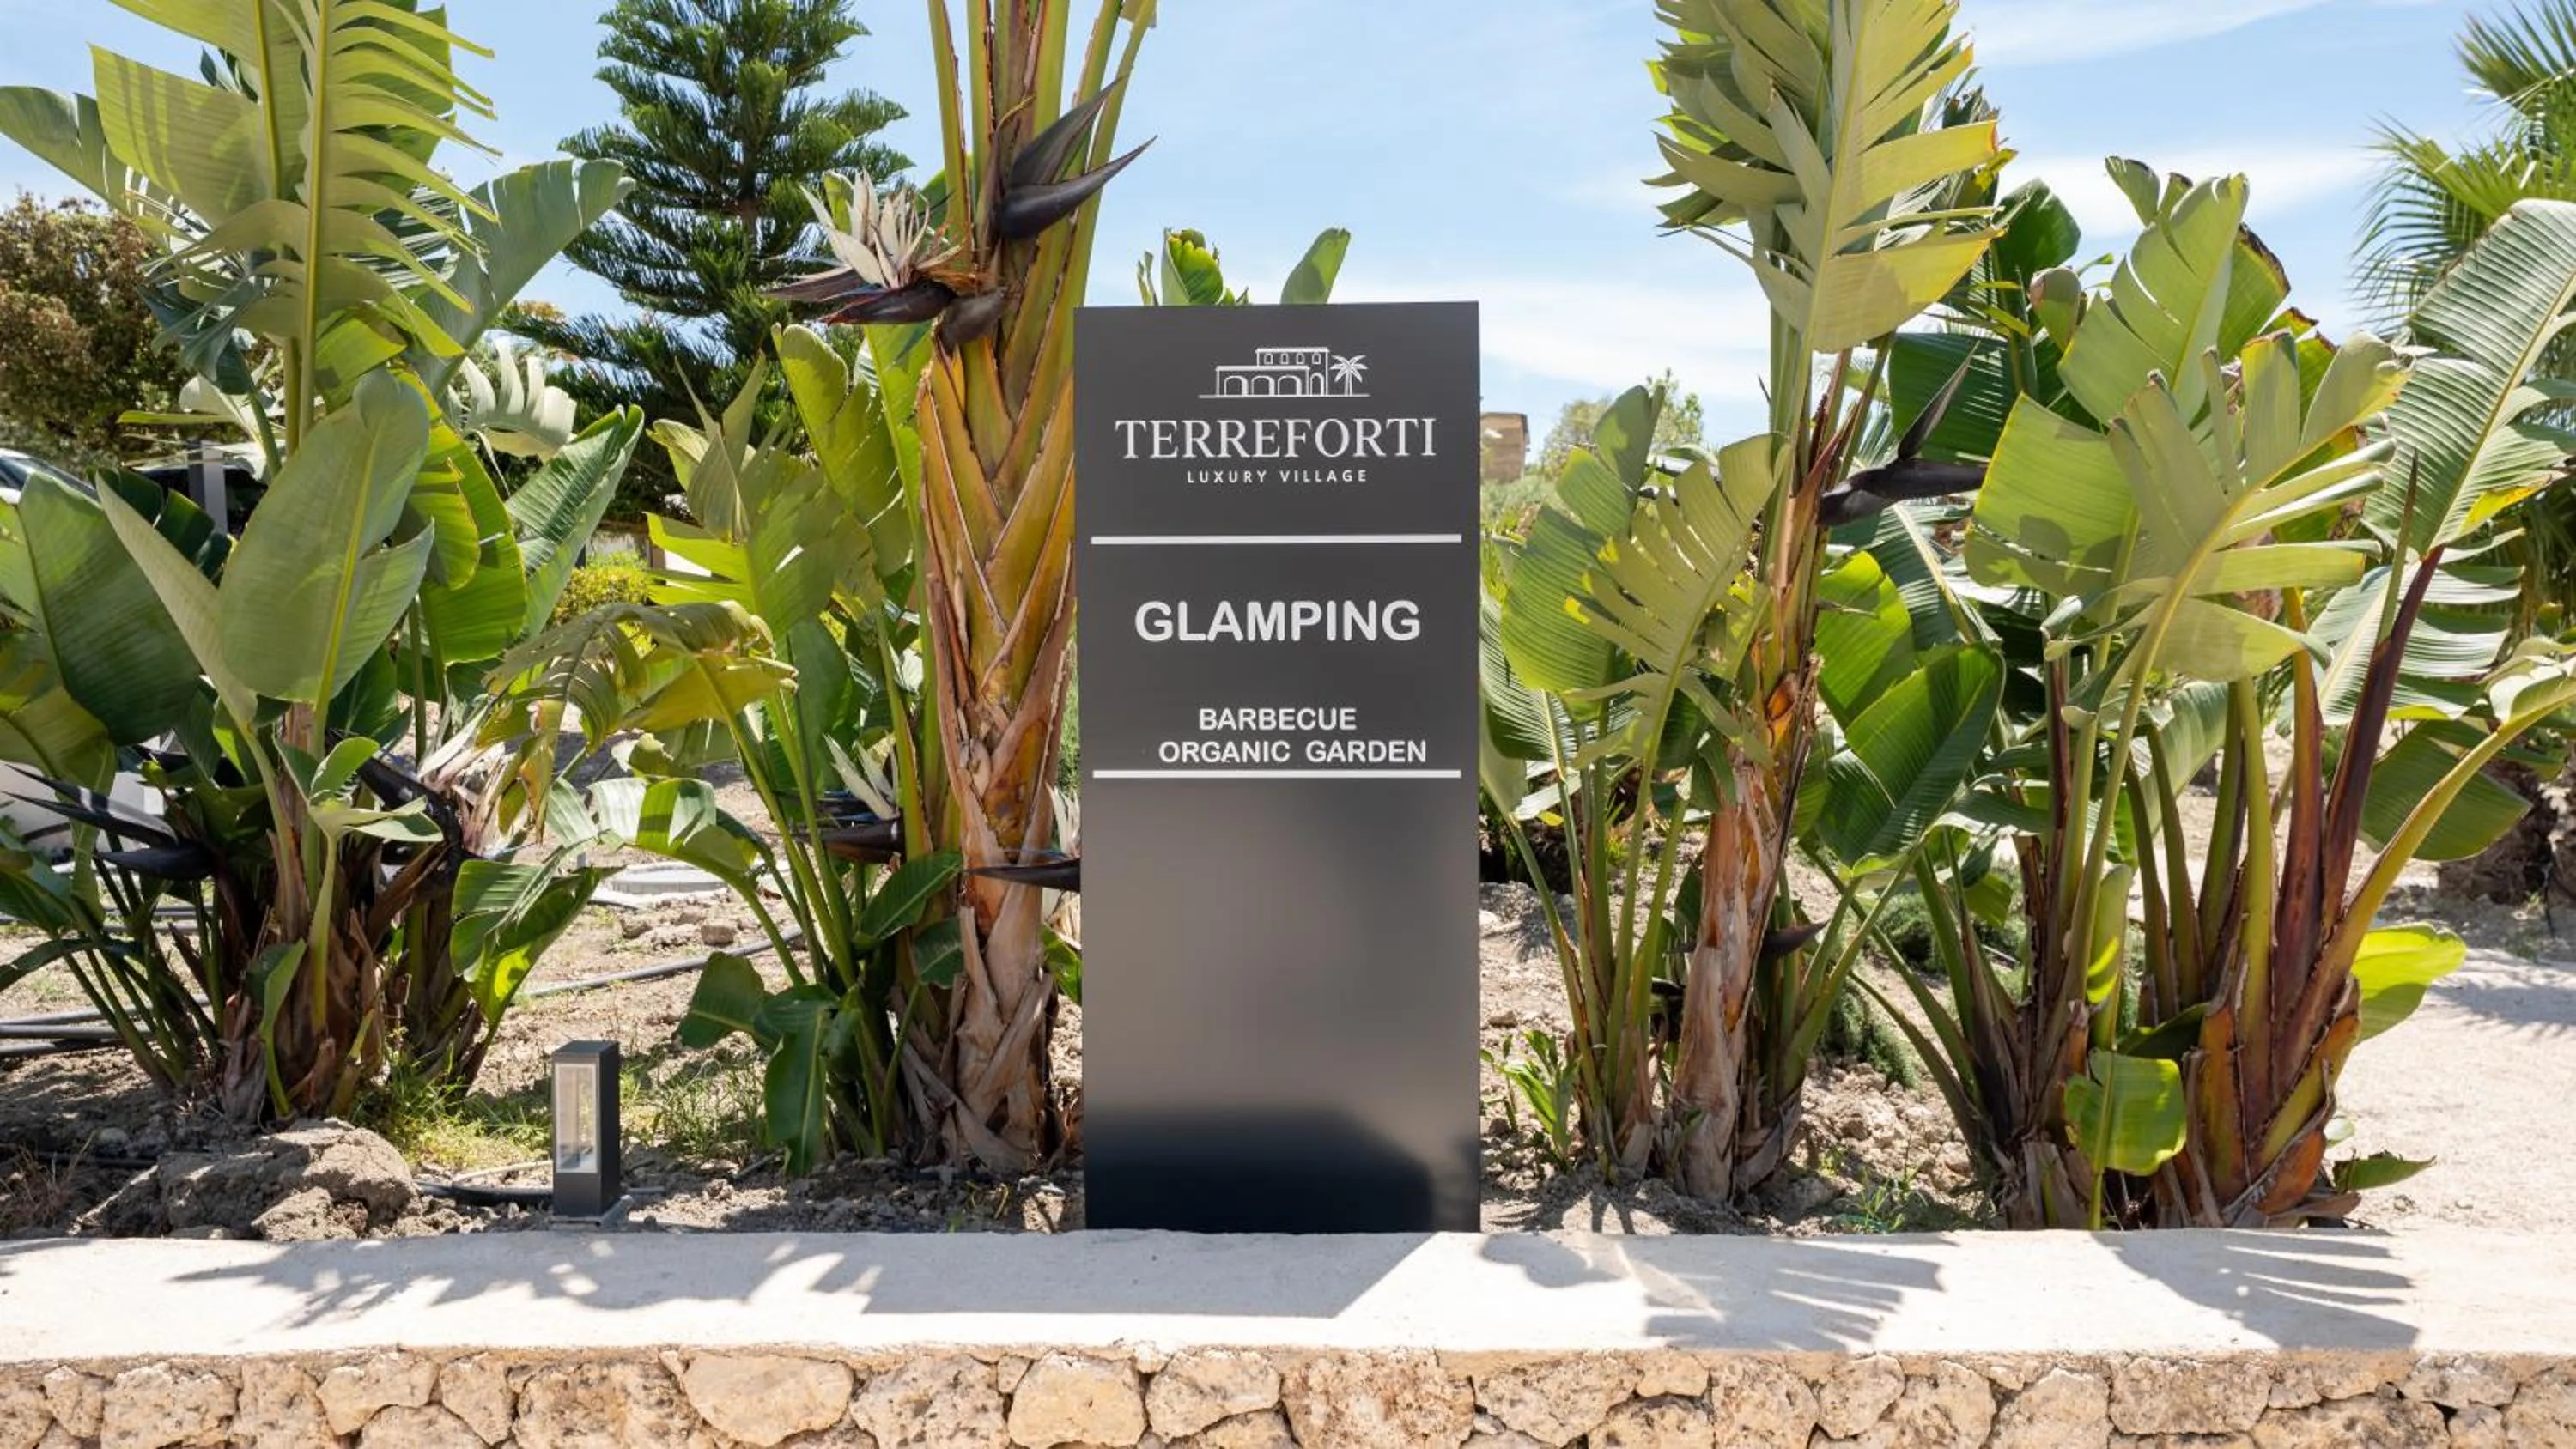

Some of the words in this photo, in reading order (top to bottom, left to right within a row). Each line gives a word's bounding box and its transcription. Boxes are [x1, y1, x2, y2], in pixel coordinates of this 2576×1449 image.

[1115, 417, 1437, 459] TERREFORTI
[1187, 470, 1267, 484] LUXURY
[1279, 469, 1367, 483] VILLAGE
[1134, 599, 1421, 643] GLAMPING
[1199, 706, 1358, 731] BARBECUE
[1158, 739, 1291, 764] ORGANIC
[1305, 739, 1427, 764] GARDEN
